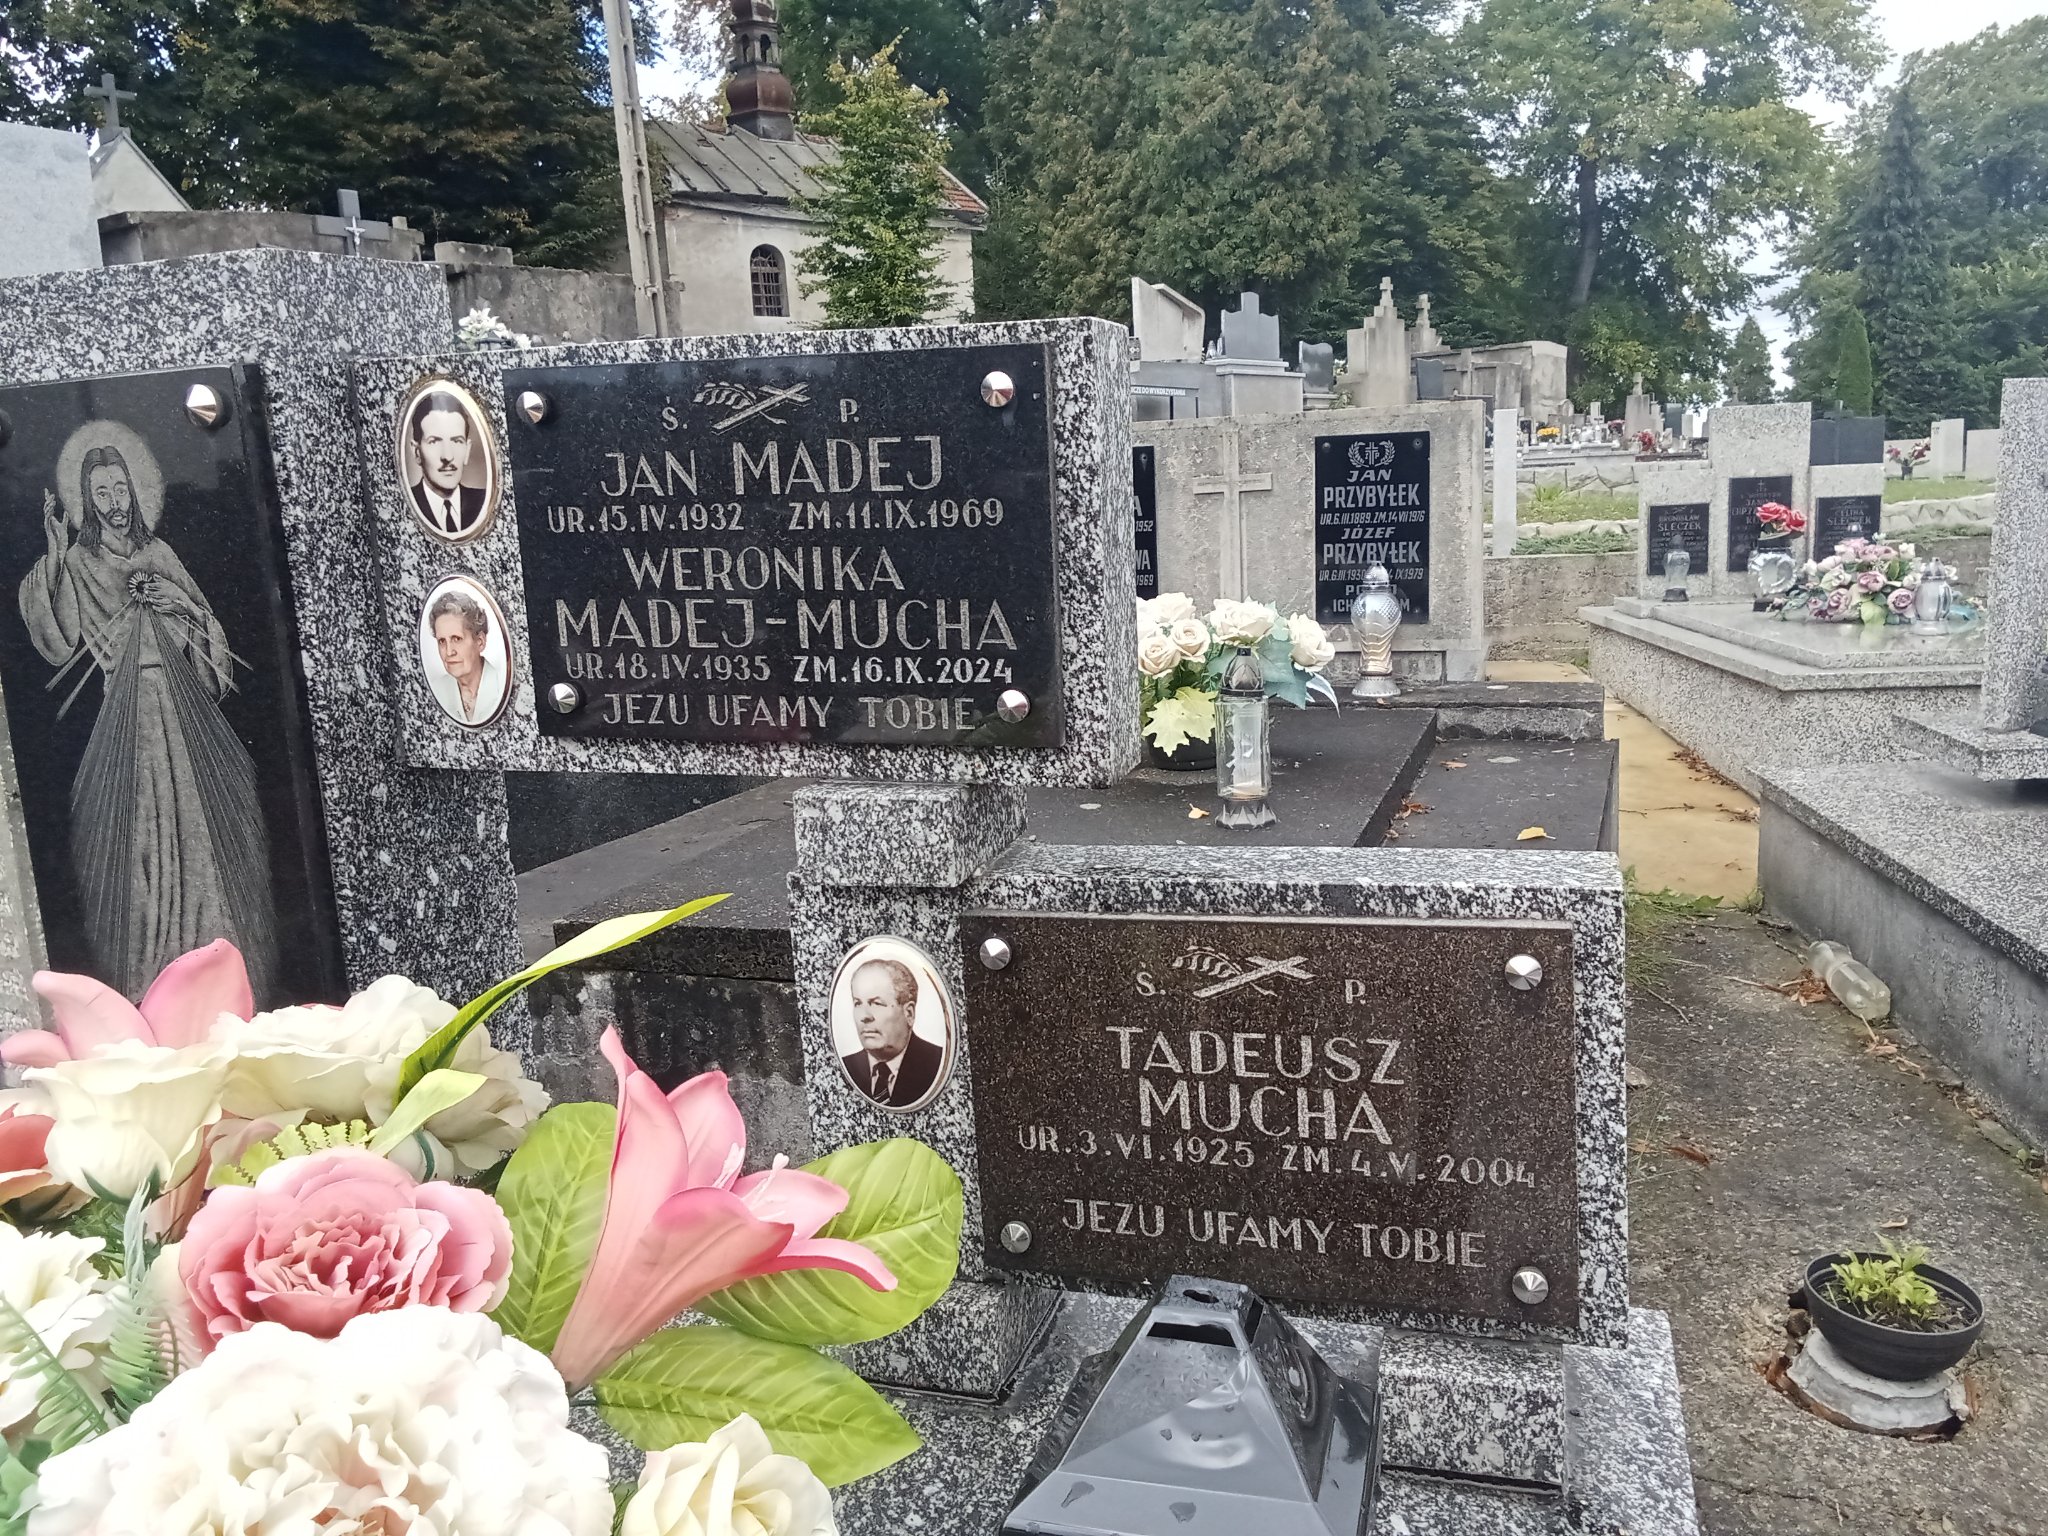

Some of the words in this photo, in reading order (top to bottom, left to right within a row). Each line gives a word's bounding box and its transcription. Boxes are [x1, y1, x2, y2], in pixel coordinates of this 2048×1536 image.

[600, 449, 699, 498] JAN
[732, 434, 942, 496] MADEJ
[1346, 469, 1392, 483] JAN
[1323, 483, 1420, 509] PRZYBYŁEK
[547, 502, 745, 534] UR.15.IV.1932
[788, 497, 1004, 532] ZM.11.IX.1969
[1341, 525, 1396, 540] JÓZEF
[623, 545, 905, 593] WERONIKA
[1323, 541, 1421, 565] PRZYBYŁEK
[556, 598, 1018, 652] MADEJ-MUCHA
[566, 653, 771, 682] UR.18.IV.1935
[793, 656, 1013, 685] ZM.16.IX.2024
[603, 693, 690, 727] JEZU
[708, 695, 834, 730] UFAMY
[858, 696, 976, 731] TOBIE
[1105, 1025, 1405, 1086] TADEUSZ
[1138, 1077, 1393, 1146] MUCHA
[1062, 1198, 1166, 1238] JEZU
[1186, 1208, 1336, 1255] UFAMY
[1353, 1222, 1488, 1269] TOBIE
